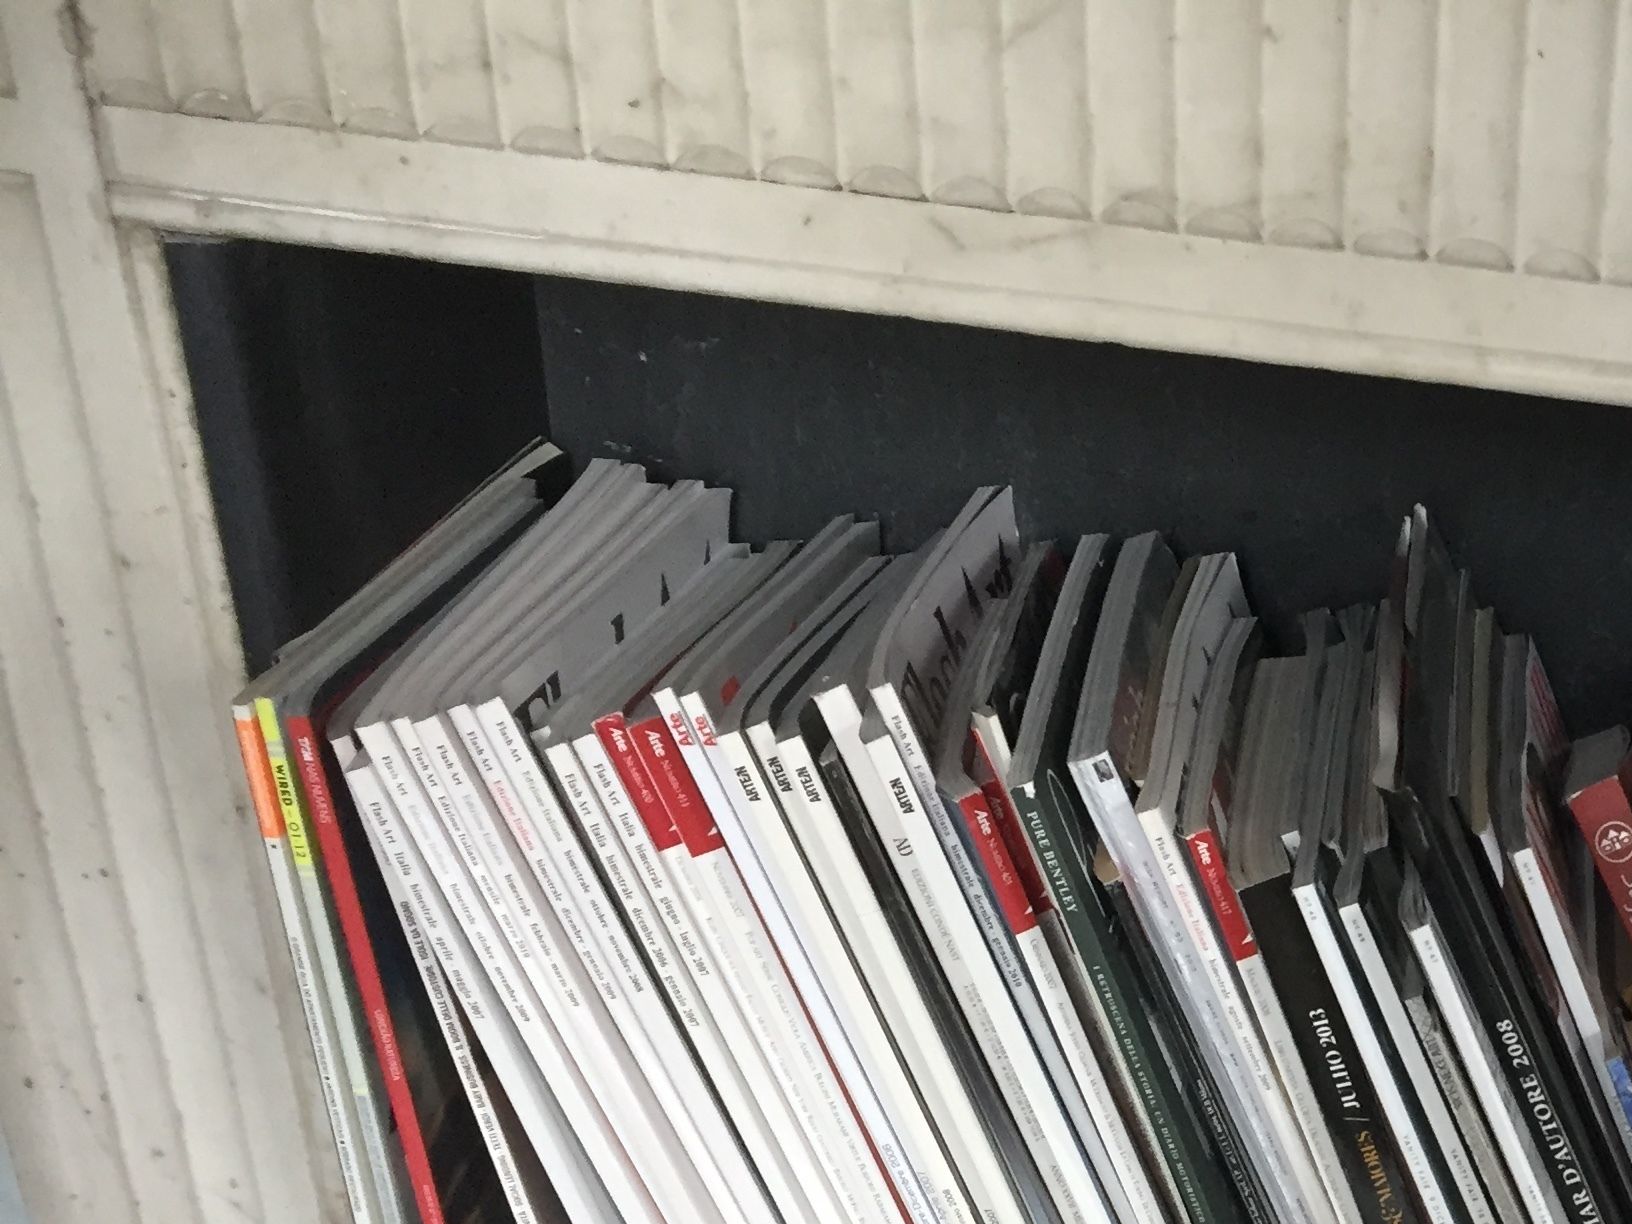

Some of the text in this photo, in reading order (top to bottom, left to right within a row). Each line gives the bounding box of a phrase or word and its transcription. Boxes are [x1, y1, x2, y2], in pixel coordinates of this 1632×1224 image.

[609, 726, 628, 752] Arte
[645, 728, 666, 758] Arte
[670, 713, 695, 746] Arte
[695, 716, 718, 746] Arte
[891, 715, 906, 741] Flash
[275, 764, 292, 806] WIRED
[974, 809, 992, 835] Arte
[1026, 810, 1079, 914] PURE BENTLEY
[1195, 840, 1212, 865] Arte
[1305, 1005, 1338, 1050] 2013
[1496, 1018, 1530, 1068] 2008
[1094, 972, 1180, 1158] RETROSCENA DELLA DIARIO
[1320, 1047, 1362, 1113] JULHO
[1520, 1073, 1582, 1186] D'AUTORE
[1400, 1133, 1423, 1168] VANITY
[1415, 1169, 1431, 1191] FAIR
[1446, 1147, 1472, 1182] VANITY
[1462, 1181, 1482, 1203] FAIR
